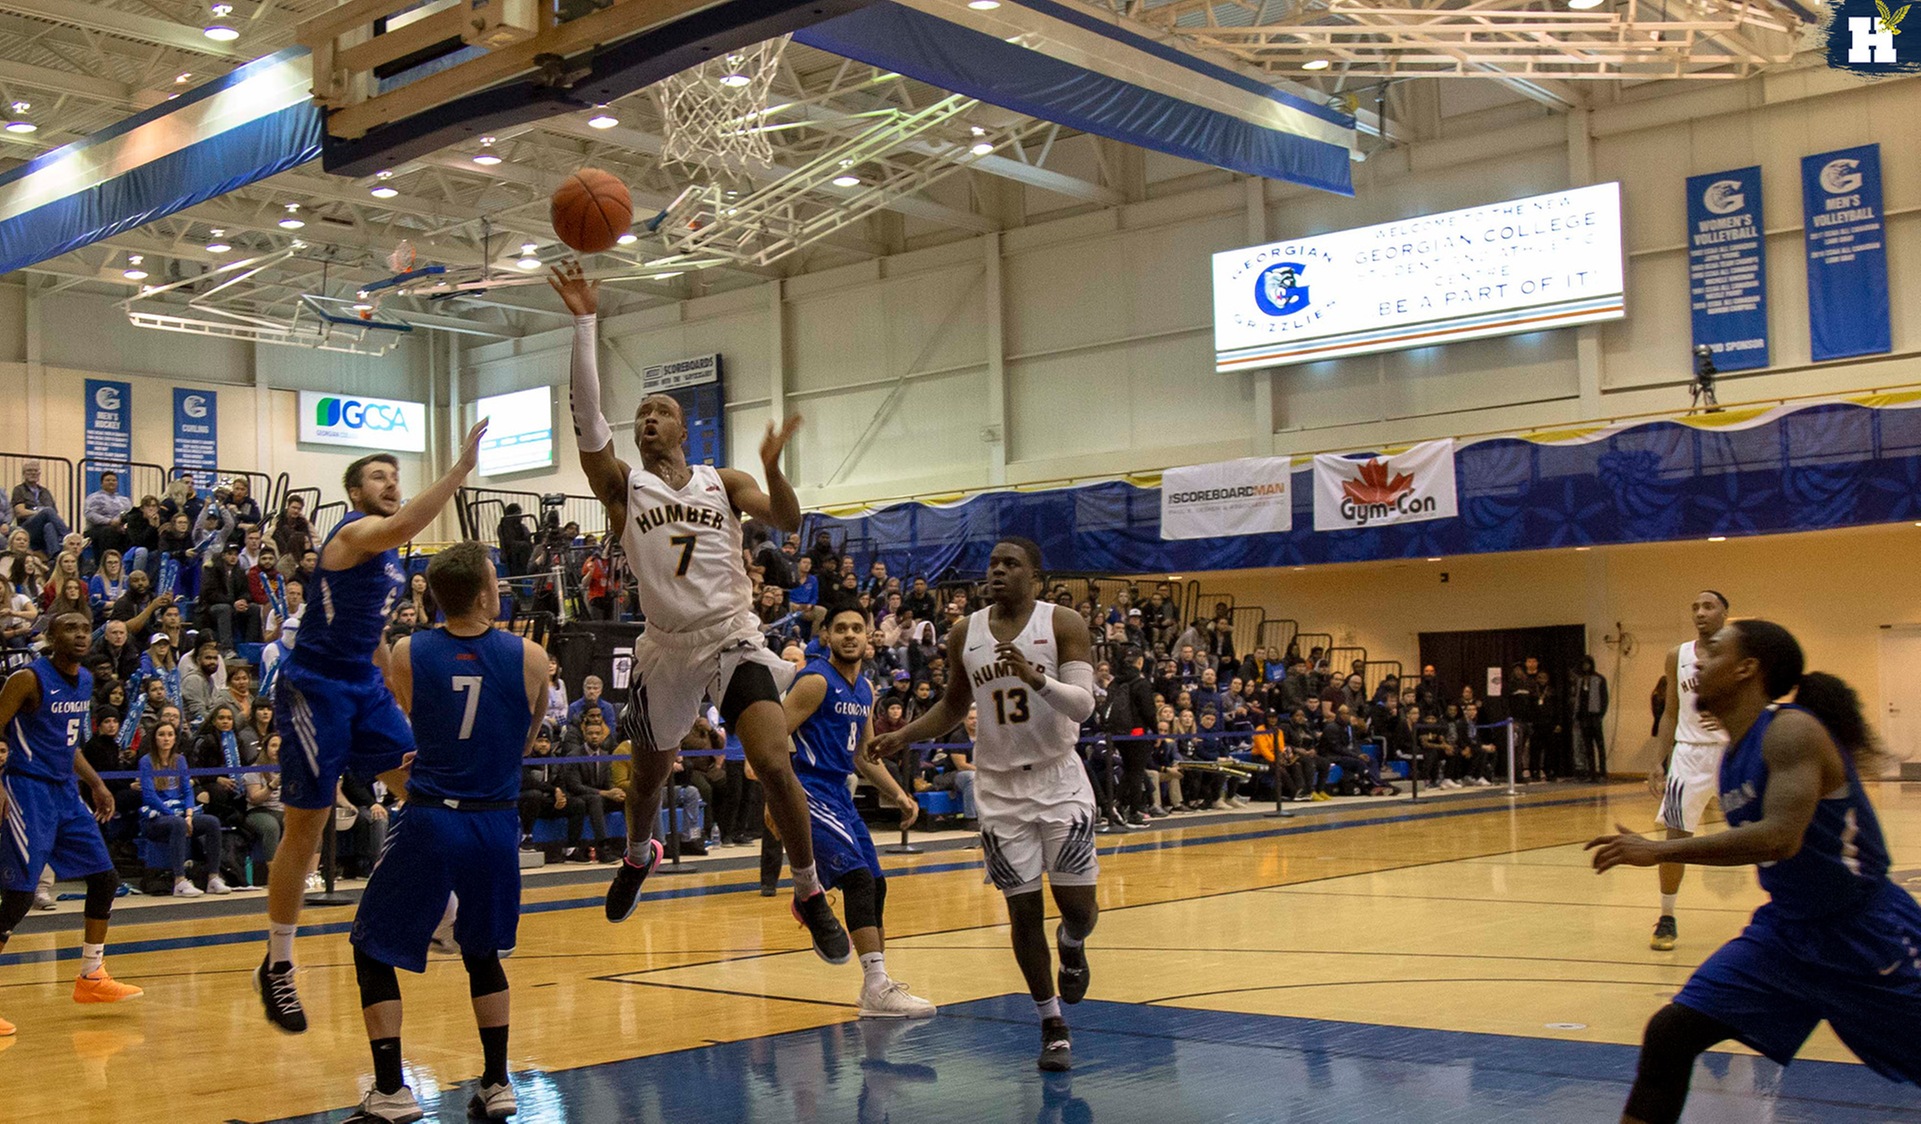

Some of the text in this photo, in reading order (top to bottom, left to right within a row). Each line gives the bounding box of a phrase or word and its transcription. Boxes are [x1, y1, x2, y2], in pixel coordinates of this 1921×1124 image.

[1812, 206, 1876, 228] VOLLEYBALL
[1825, 194, 1861, 211] MEN'S
[1355, 211, 1596, 265] GEORGIAN COLLEGE
[1693, 225, 1759, 246] VOLLEYBALL
[1698, 213, 1753, 233] WOMEN'S
[1379, 298, 1408, 316] BE
[1420, 295, 1432, 308] A
[1445, 283, 1508, 306] PART
[1520, 276, 1553, 295] OF
[1233, 299, 1337, 333] GRIZZLIE
[1725, 338, 1765, 352] SPONSOR
[663, 356, 714, 376] SCOREBOARDS
[341, 400, 409, 433] GCSA
[635, 503, 725, 535] HUMBER
[1340, 492, 1436, 526] Gym-Con
[669, 532, 698, 578] 7
[971, 660, 1047, 689] HUMR
[451, 675, 484, 740] 7
[991, 686, 1031, 726] 13
[66, 718, 80, 747] 5
